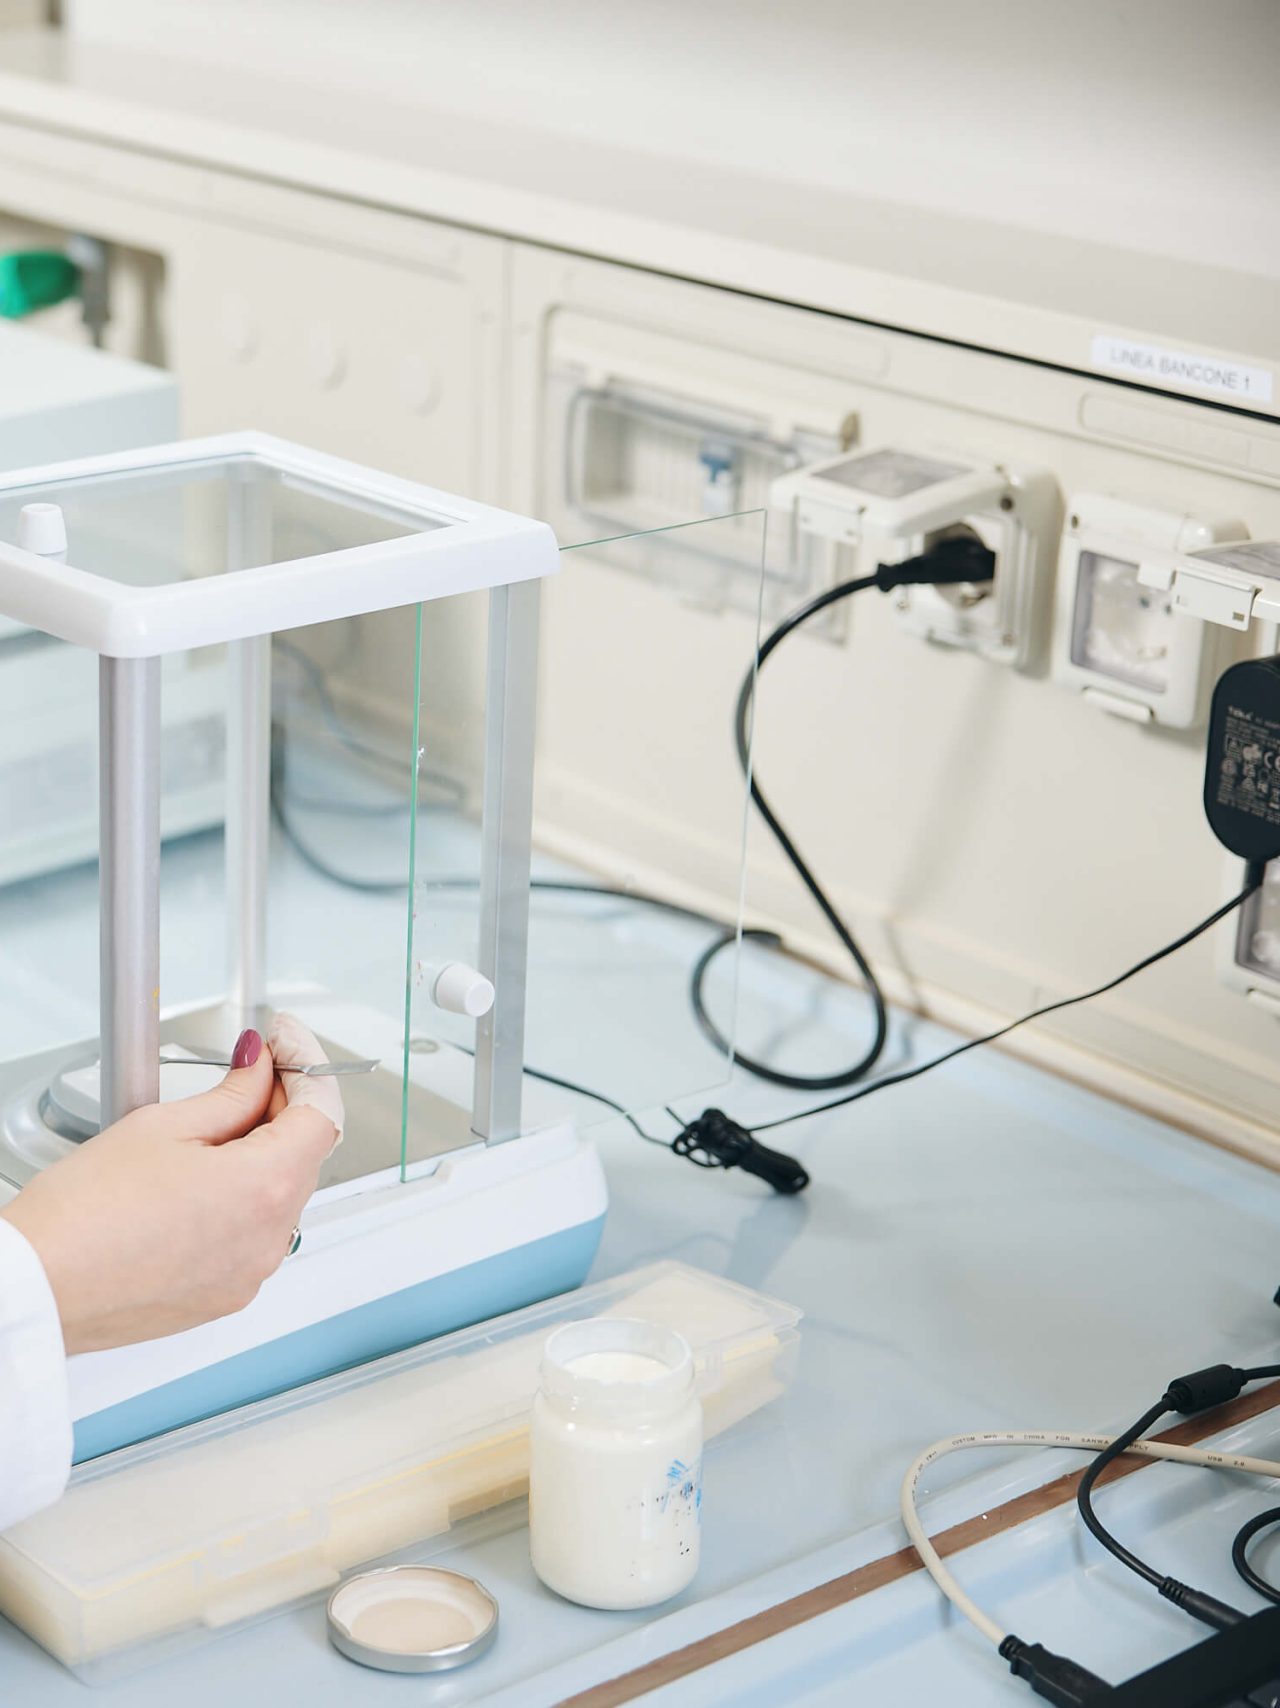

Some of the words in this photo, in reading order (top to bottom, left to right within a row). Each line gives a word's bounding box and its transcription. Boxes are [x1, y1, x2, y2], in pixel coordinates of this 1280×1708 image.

[1110, 348, 1154, 369] LINEA
[1159, 354, 1238, 389] BANCONE
[1244, 375, 1251, 391] 1
[951, 1436, 976, 1446] CUSTOM
[1081, 1437, 1110, 1446] SANWA
